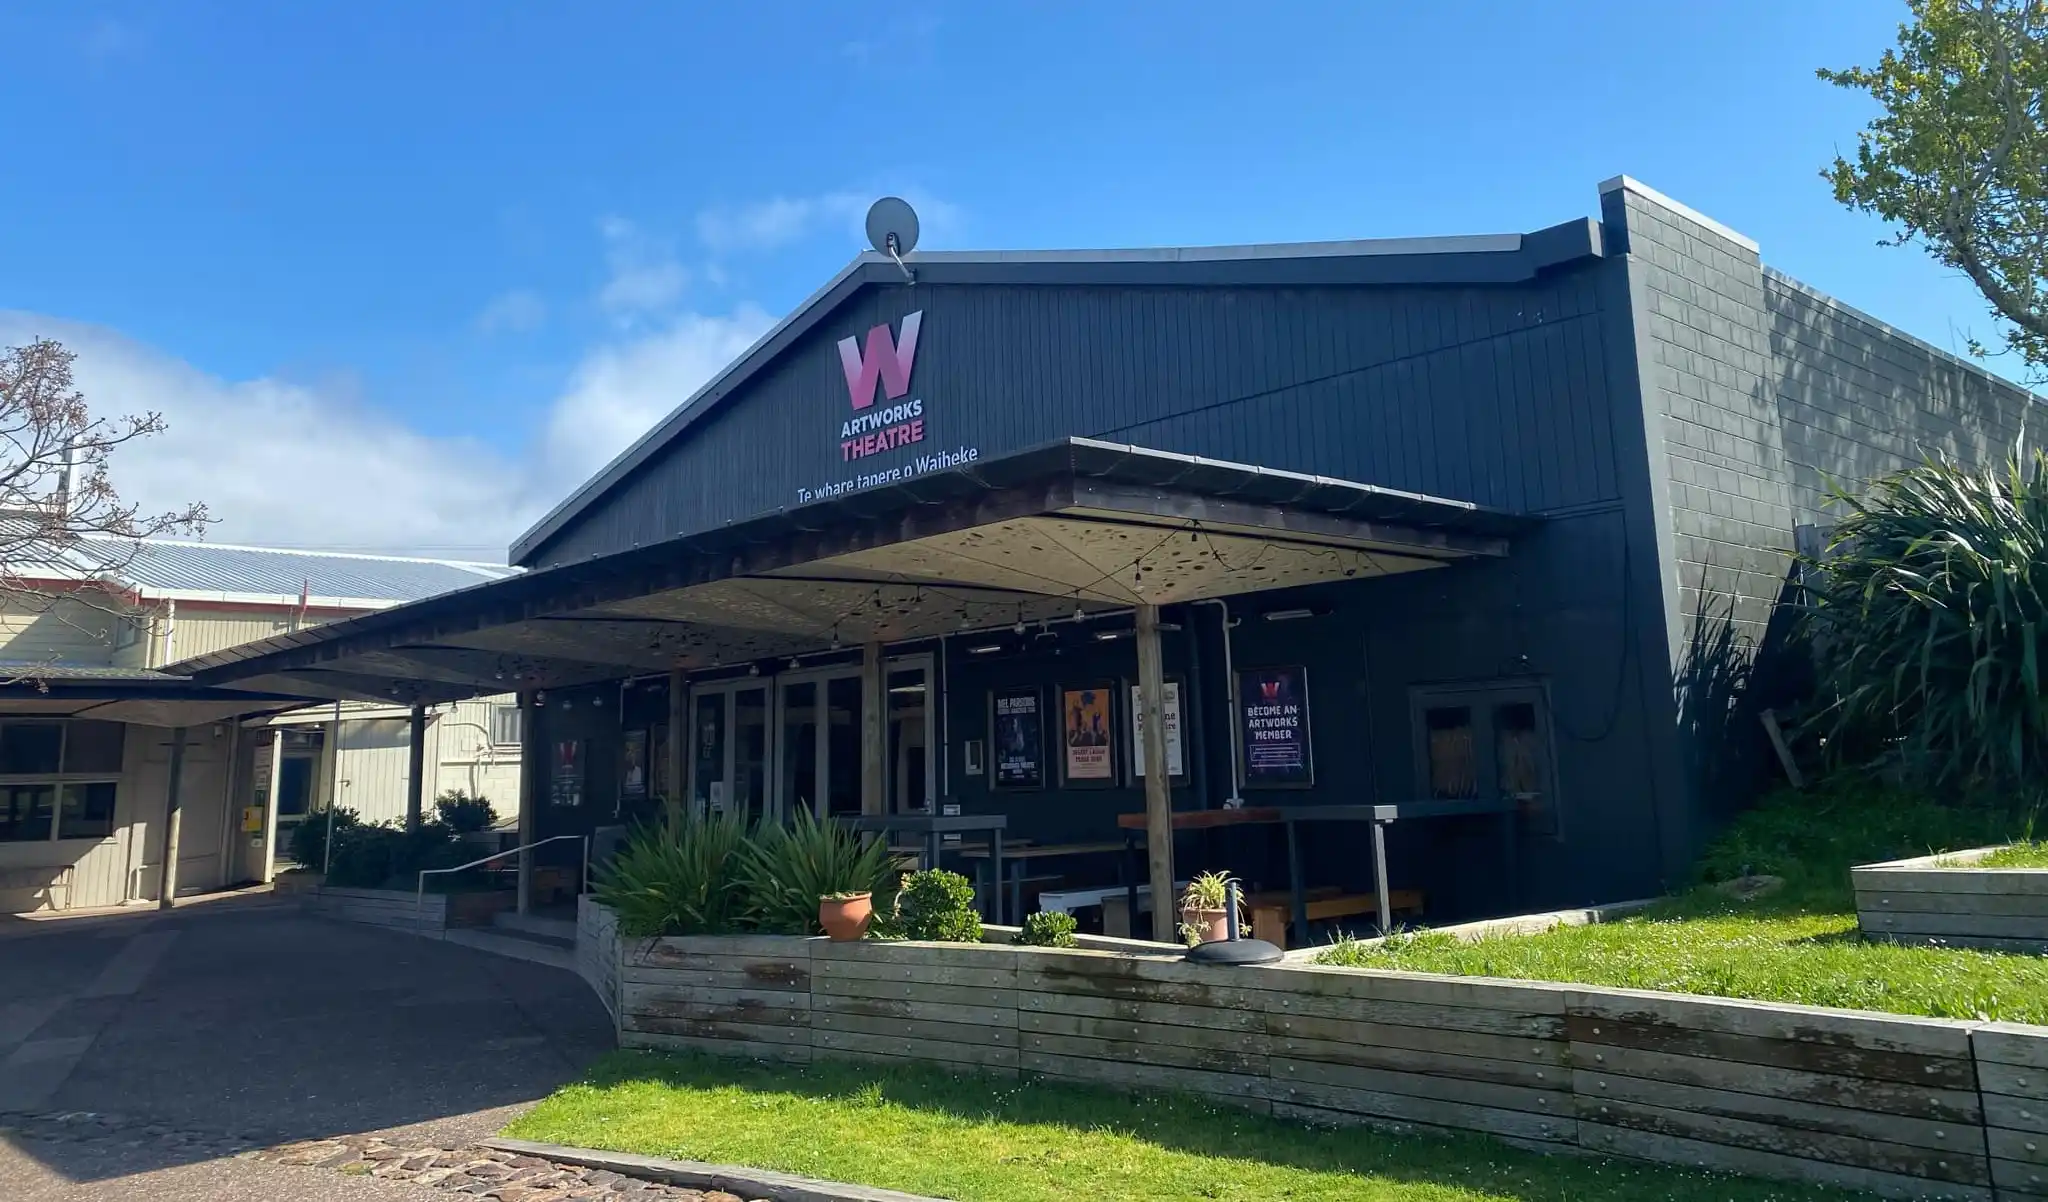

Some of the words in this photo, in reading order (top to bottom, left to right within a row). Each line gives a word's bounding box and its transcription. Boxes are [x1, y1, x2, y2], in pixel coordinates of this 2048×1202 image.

[837, 310, 923, 411] W
[841, 399, 923, 438] ARTWORKS
[841, 420, 924, 462] THEATRE
[798, 488, 812, 504] Te
[815, 479, 854, 499] whare
[904, 464, 912, 478] o
[916, 446, 978, 474] Waiheke
[1247, 705, 1281, 717] BECOME
[1284, 705, 1297, 715] AN
[1248, 717, 1298, 729] ARTWORKS
[1255, 730, 1292, 740] MEMBER
